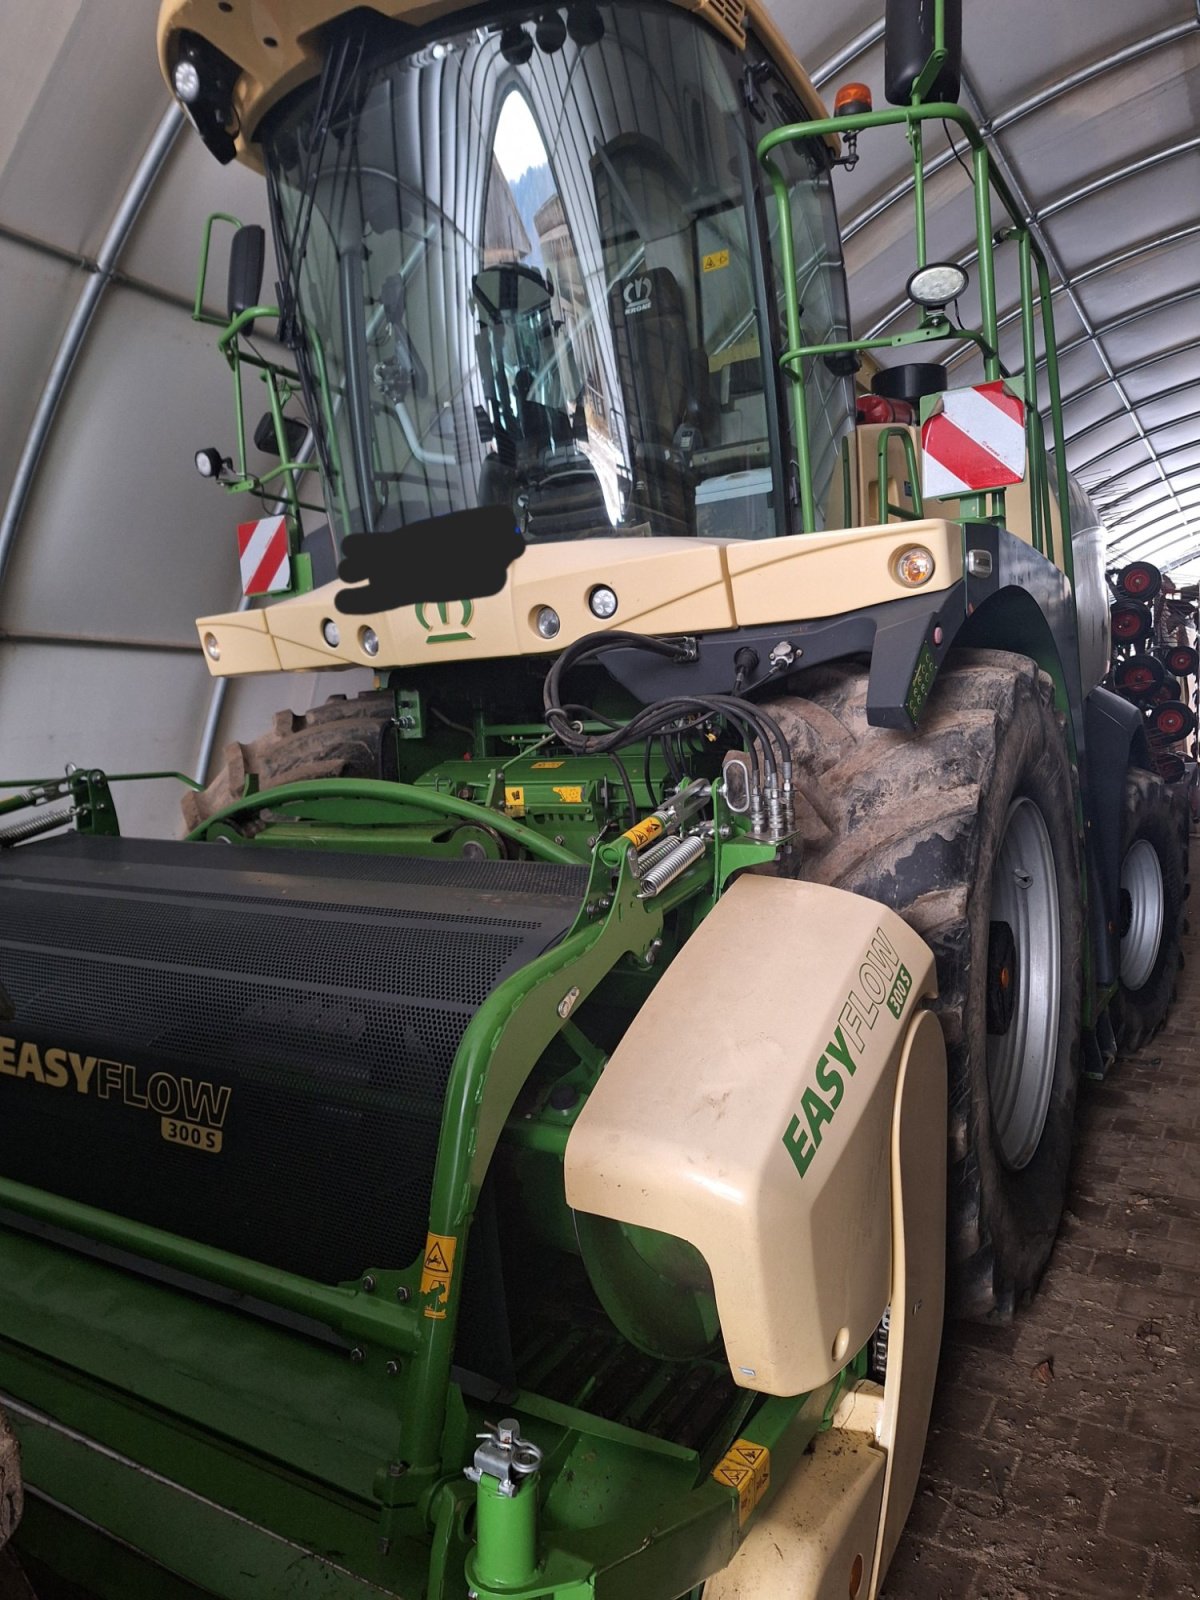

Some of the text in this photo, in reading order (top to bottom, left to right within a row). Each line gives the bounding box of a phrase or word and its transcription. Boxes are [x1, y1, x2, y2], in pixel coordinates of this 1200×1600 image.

[889, 969, 911, 1015] 300 S
[168, 1121, 217, 1149] 300 S
